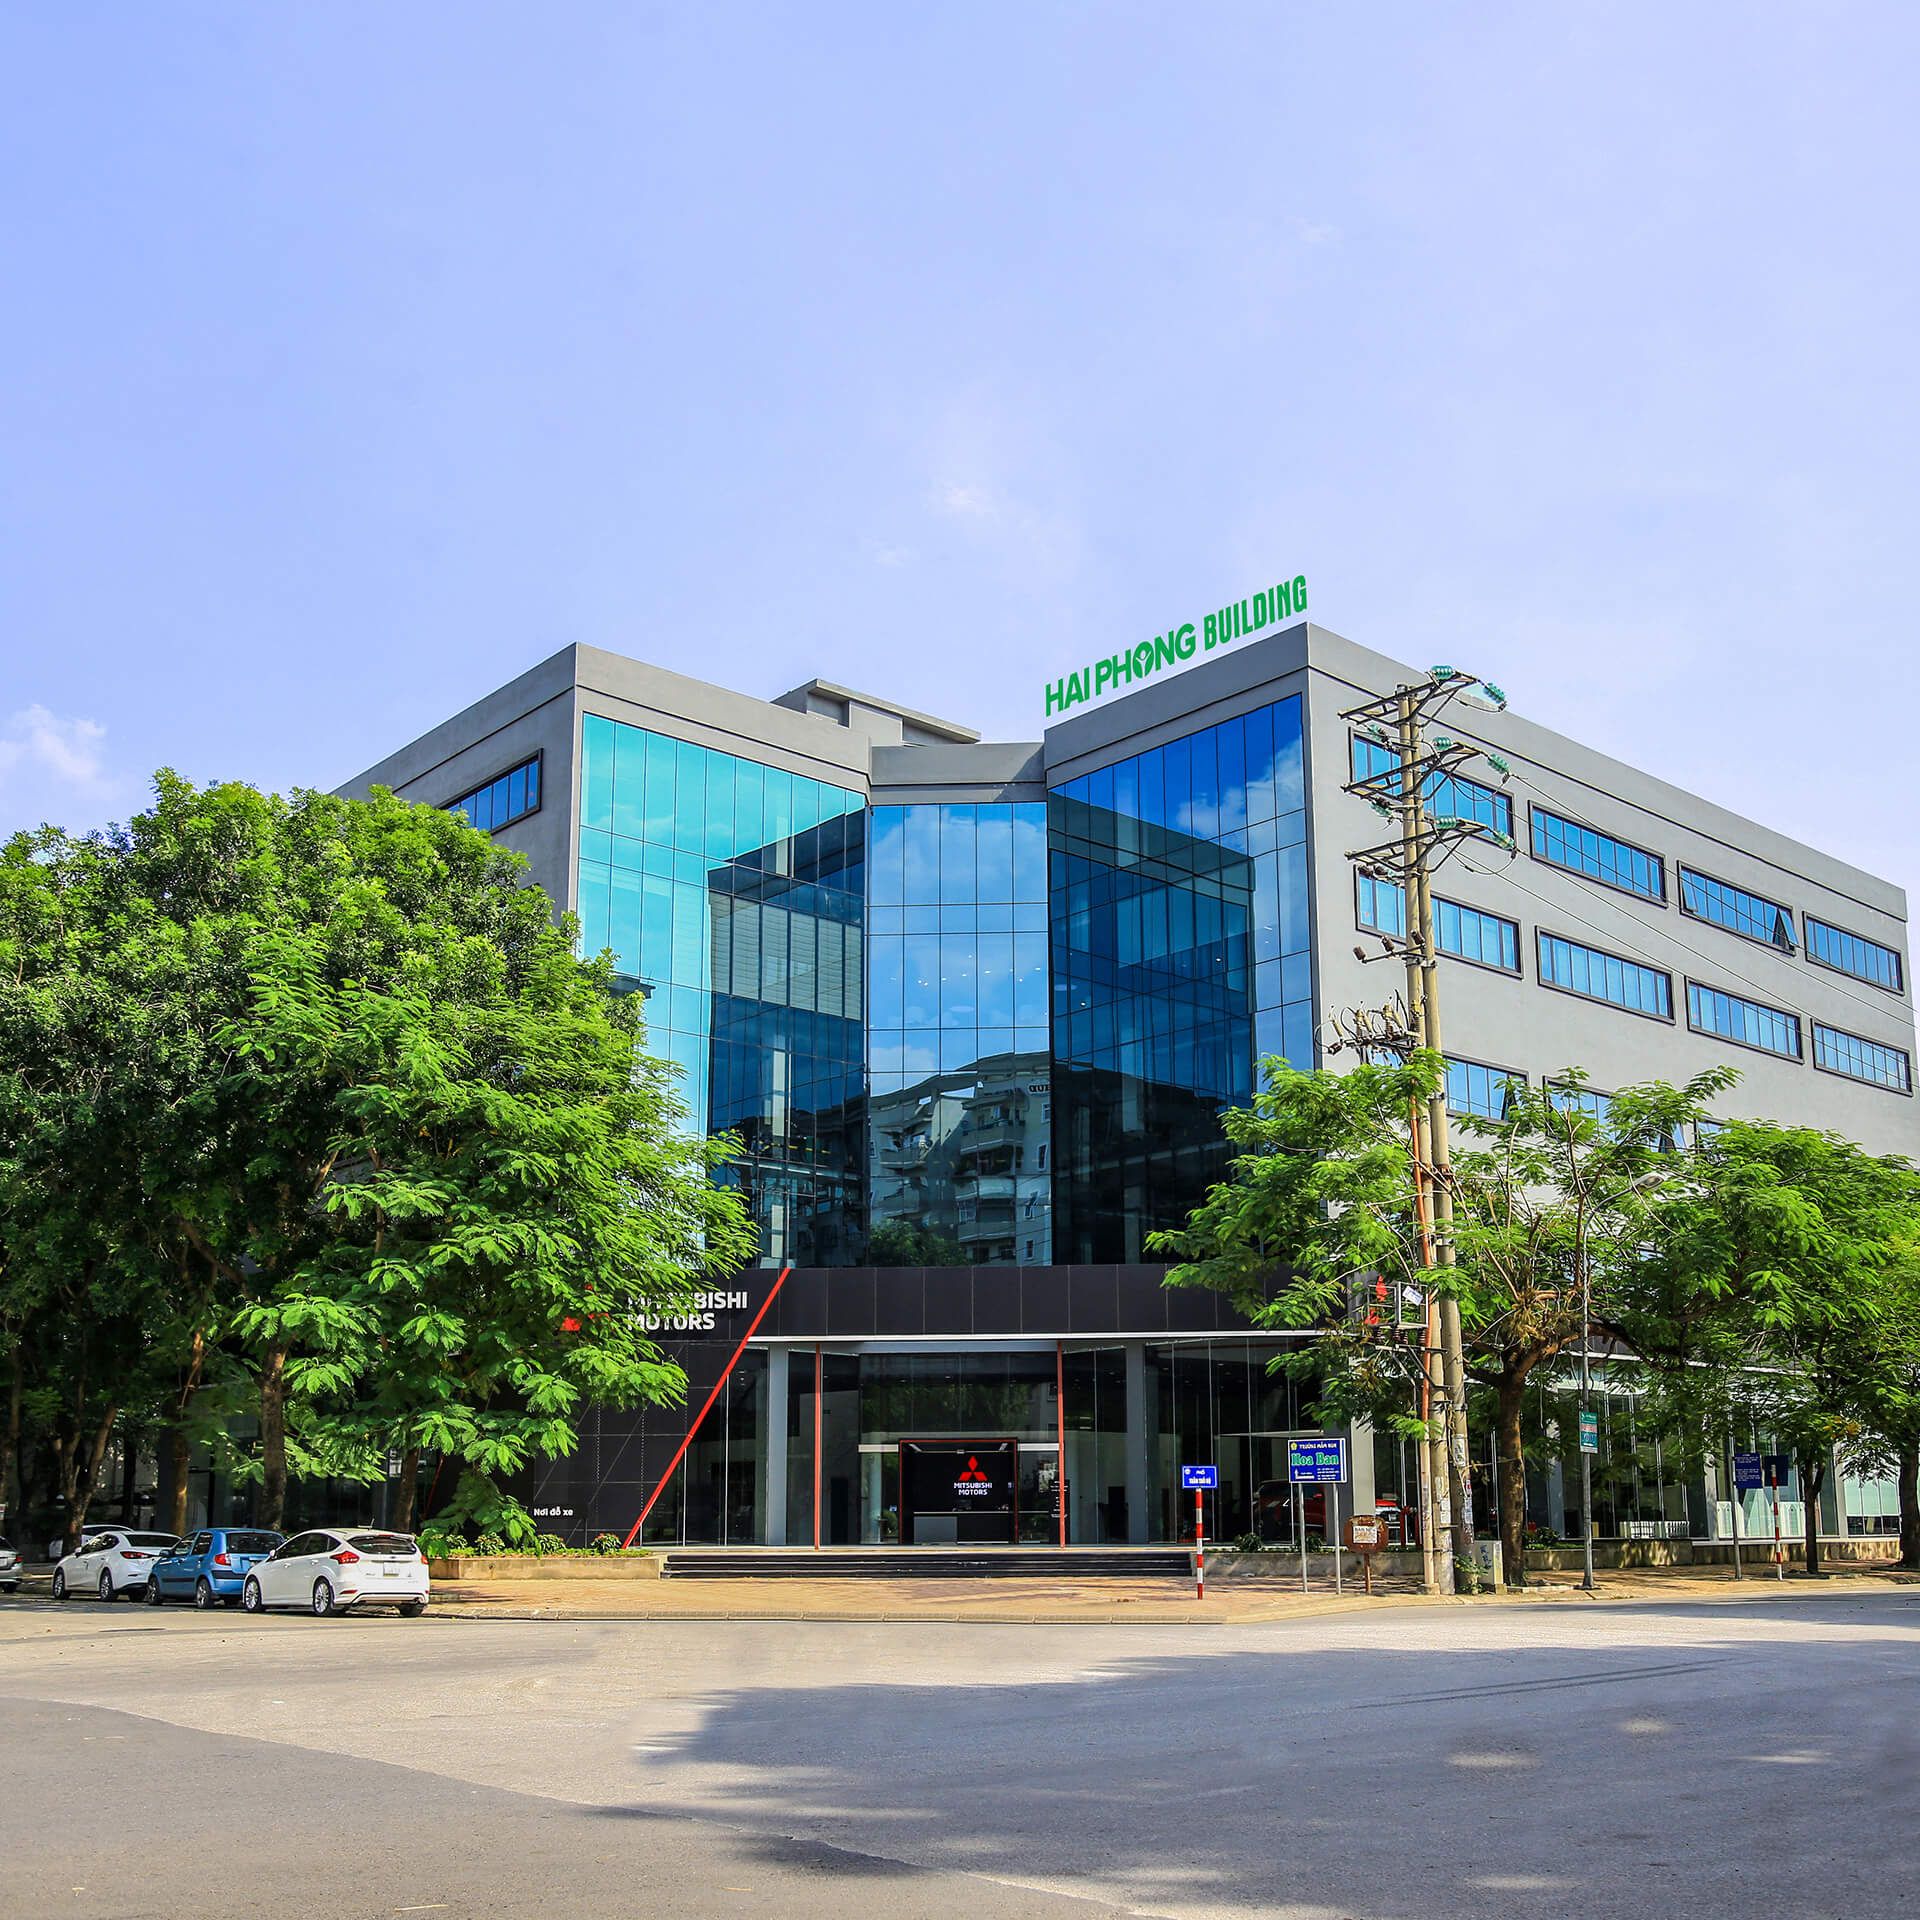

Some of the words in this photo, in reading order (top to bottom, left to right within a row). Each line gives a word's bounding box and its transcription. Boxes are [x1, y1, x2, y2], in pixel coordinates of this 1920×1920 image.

[1045, 667, 1090, 717] HAI
[1095, 623, 1196, 696] PHONG
[1203, 575, 1307, 651] BUILDING
[627, 1291, 748, 1309] MSBISHI
[1291, 1453, 1314, 1466] Hoa
[1315, 1452, 1339, 1466] Ban
